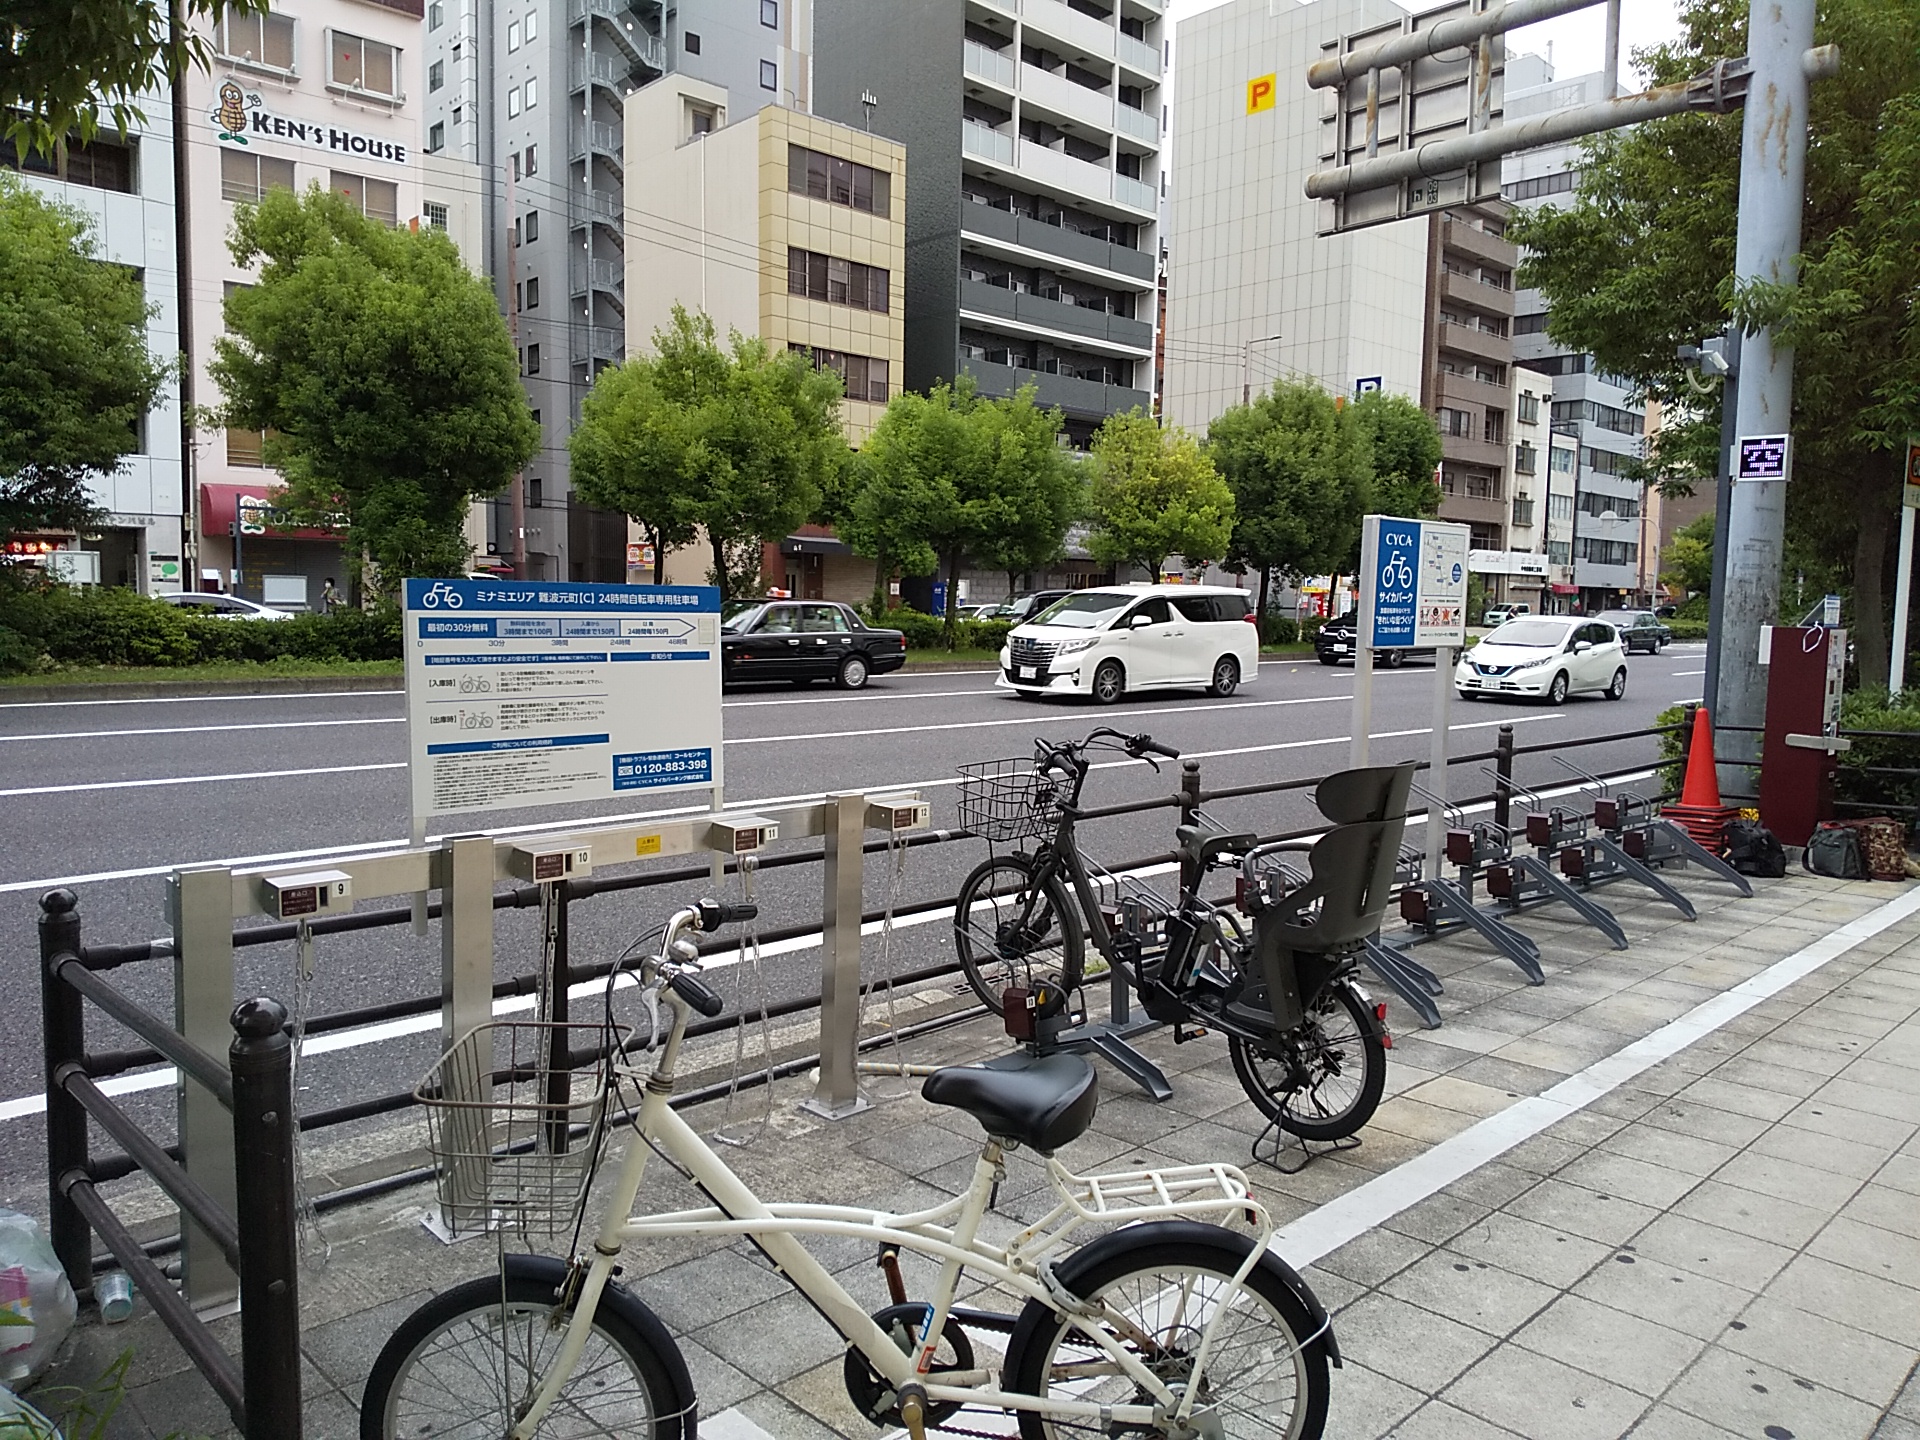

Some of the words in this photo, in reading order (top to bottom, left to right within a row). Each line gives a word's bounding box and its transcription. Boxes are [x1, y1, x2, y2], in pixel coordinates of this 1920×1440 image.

[1252, 81, 1270, 109] P
[252, 111, 323, 144] KEN'S
[329, 129, 405, 162] HOUSE
[1741, 440, 1784, 477] 空
[1385, 533, 1413, 547] CYCA
[476, 591, 535, 602] ミナミエリア
[1379, 591, 1414, 603] サイカパーク
[427, 623, 489, 632] 最初の30分無料
[417, 640, 424, 648] 0
[634, 760, 708, 775] 0120-883-398
[768, 829, 776, 838] 11
[578, 852, 588, 863] 10
[338, 883, 344, 895] 9
